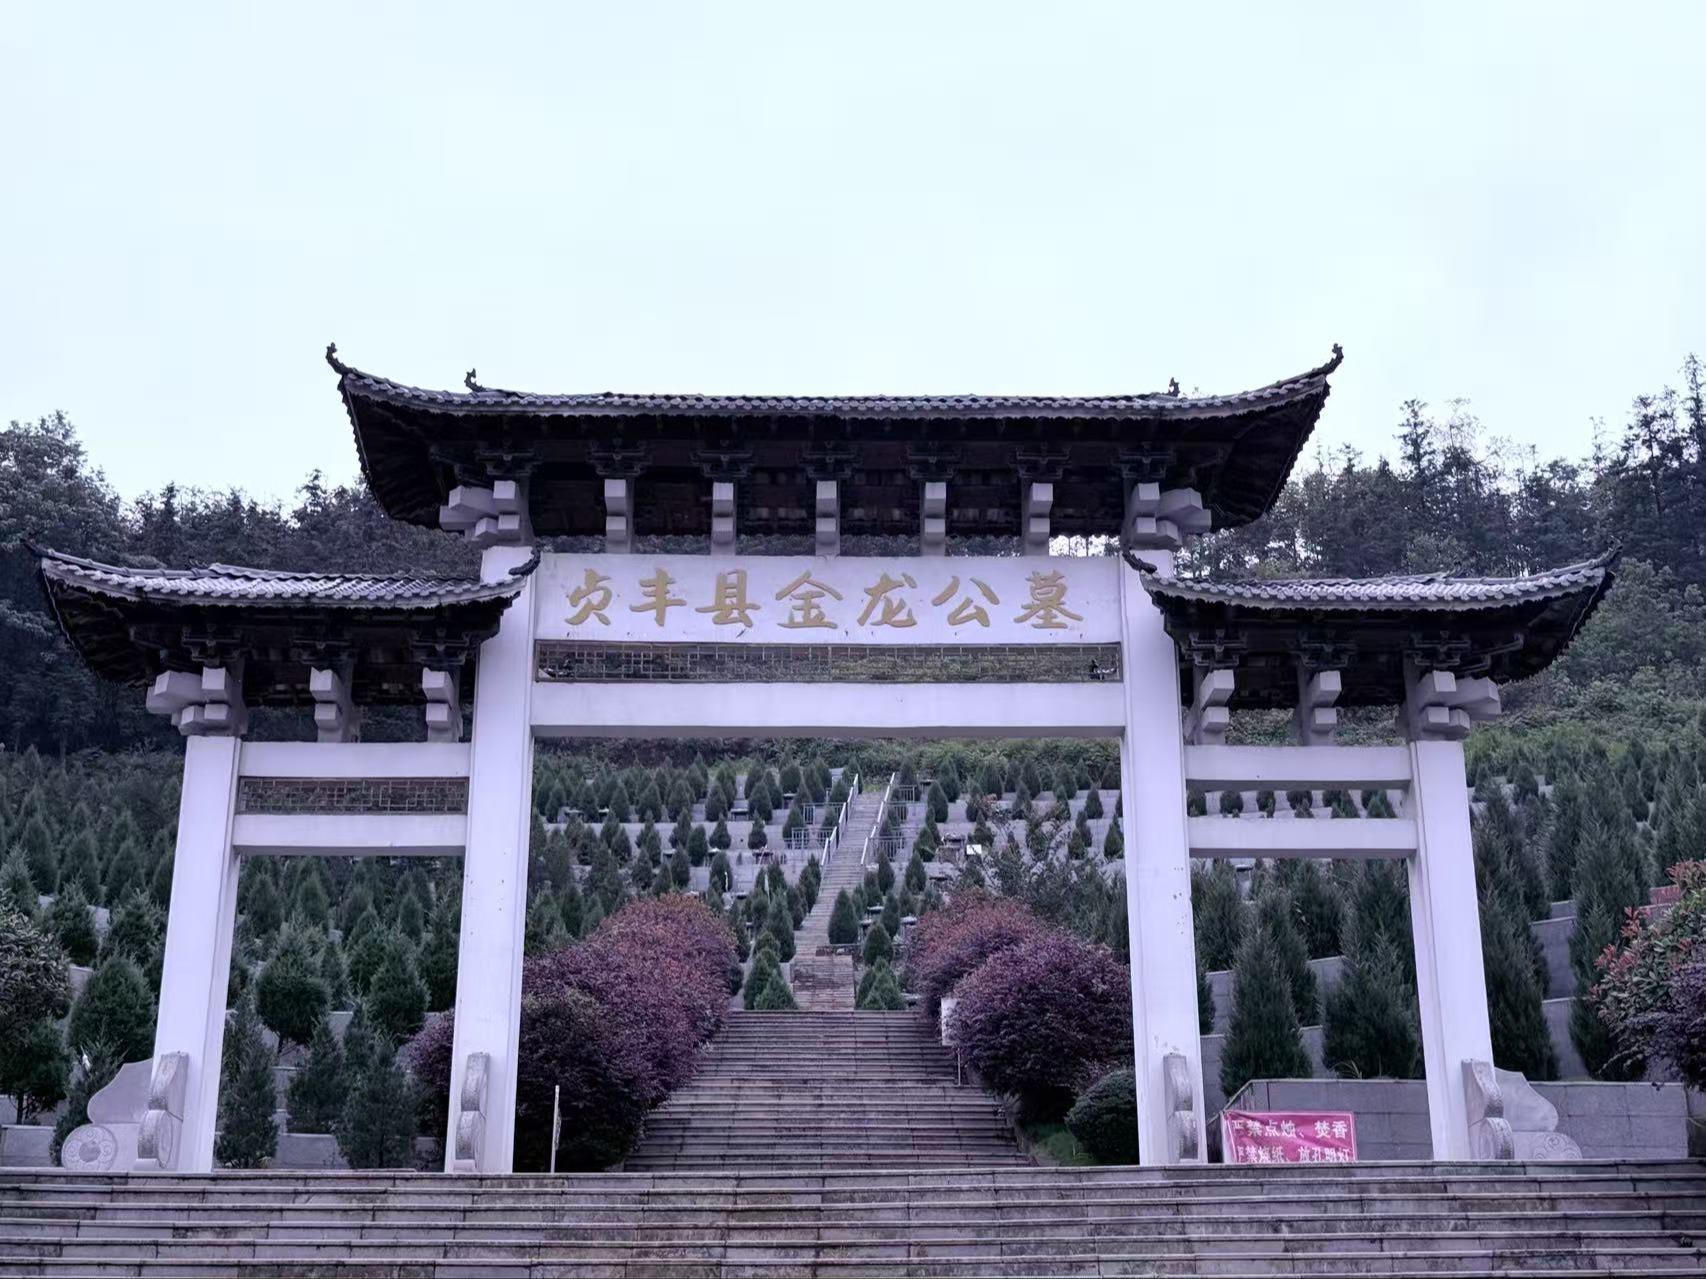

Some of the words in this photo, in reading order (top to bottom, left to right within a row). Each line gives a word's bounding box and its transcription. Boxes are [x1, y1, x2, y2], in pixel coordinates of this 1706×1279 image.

[565, 567, 1084, 630] 贞丰县金龙公墓
